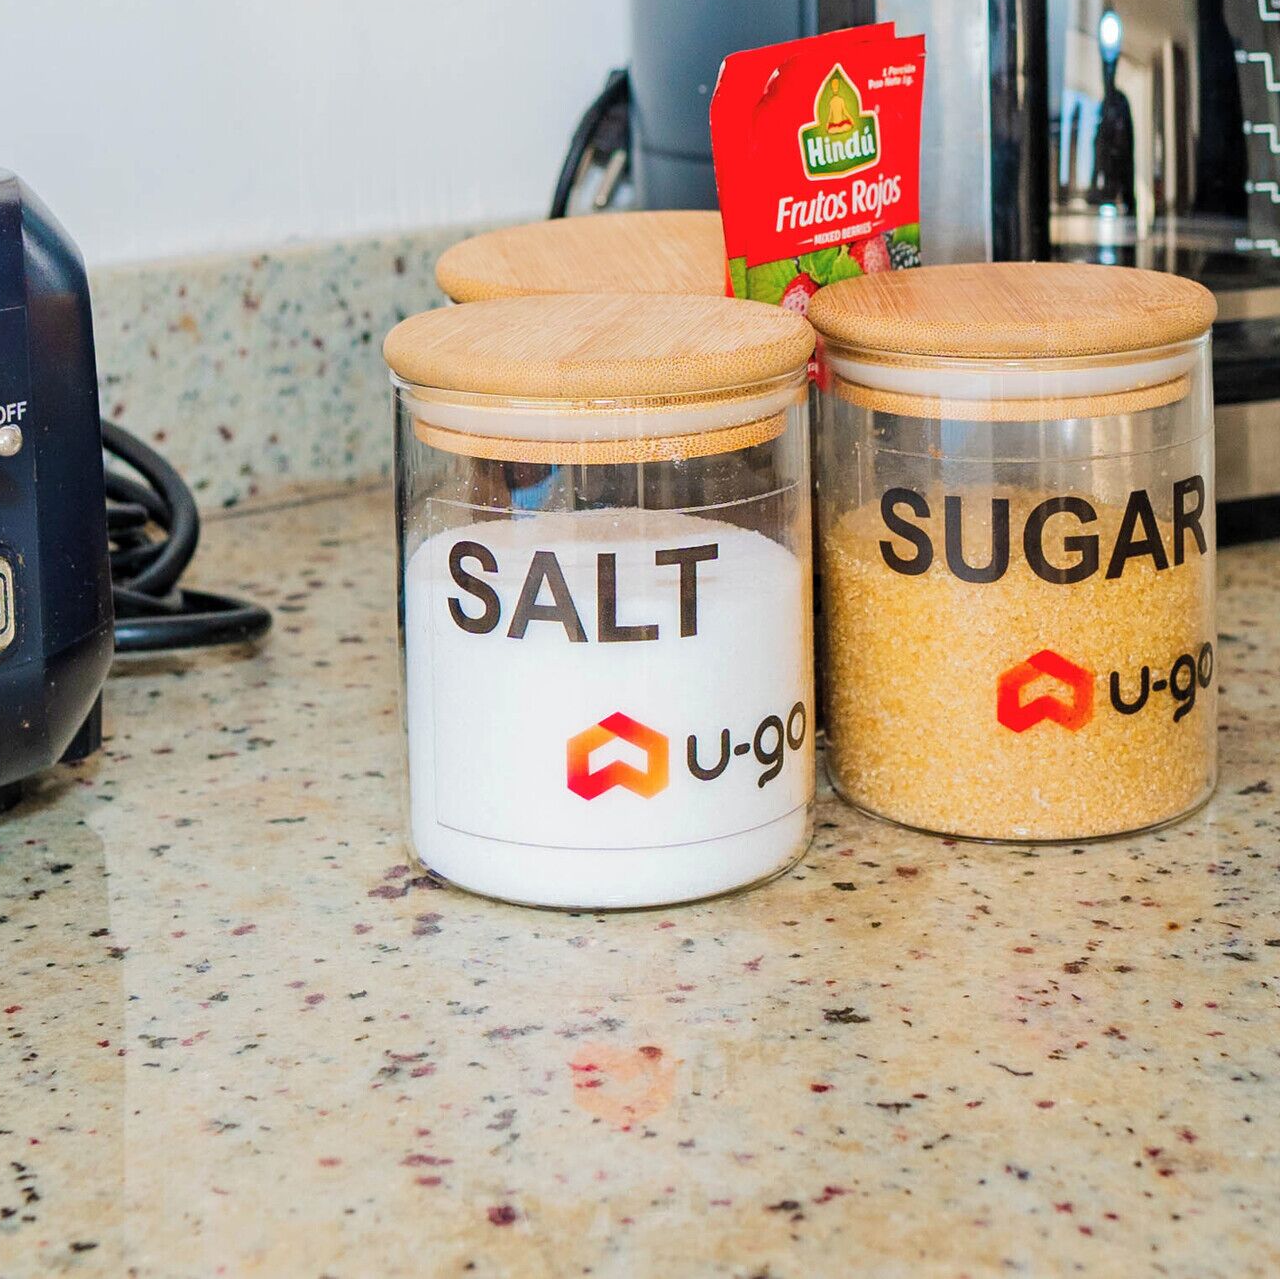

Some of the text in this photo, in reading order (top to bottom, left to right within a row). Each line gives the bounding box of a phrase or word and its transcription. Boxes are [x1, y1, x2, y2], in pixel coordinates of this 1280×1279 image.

[807, 126, 876, 168] Hindú
[776, 173, 901, 233] Frutos Rojos
[879, 474, 1207, 585] SUGAR
[447, 540, 719, 643] SALT
[1109, 641, 1214, 724] u-go
[686, 701, 807, 789] u-go
